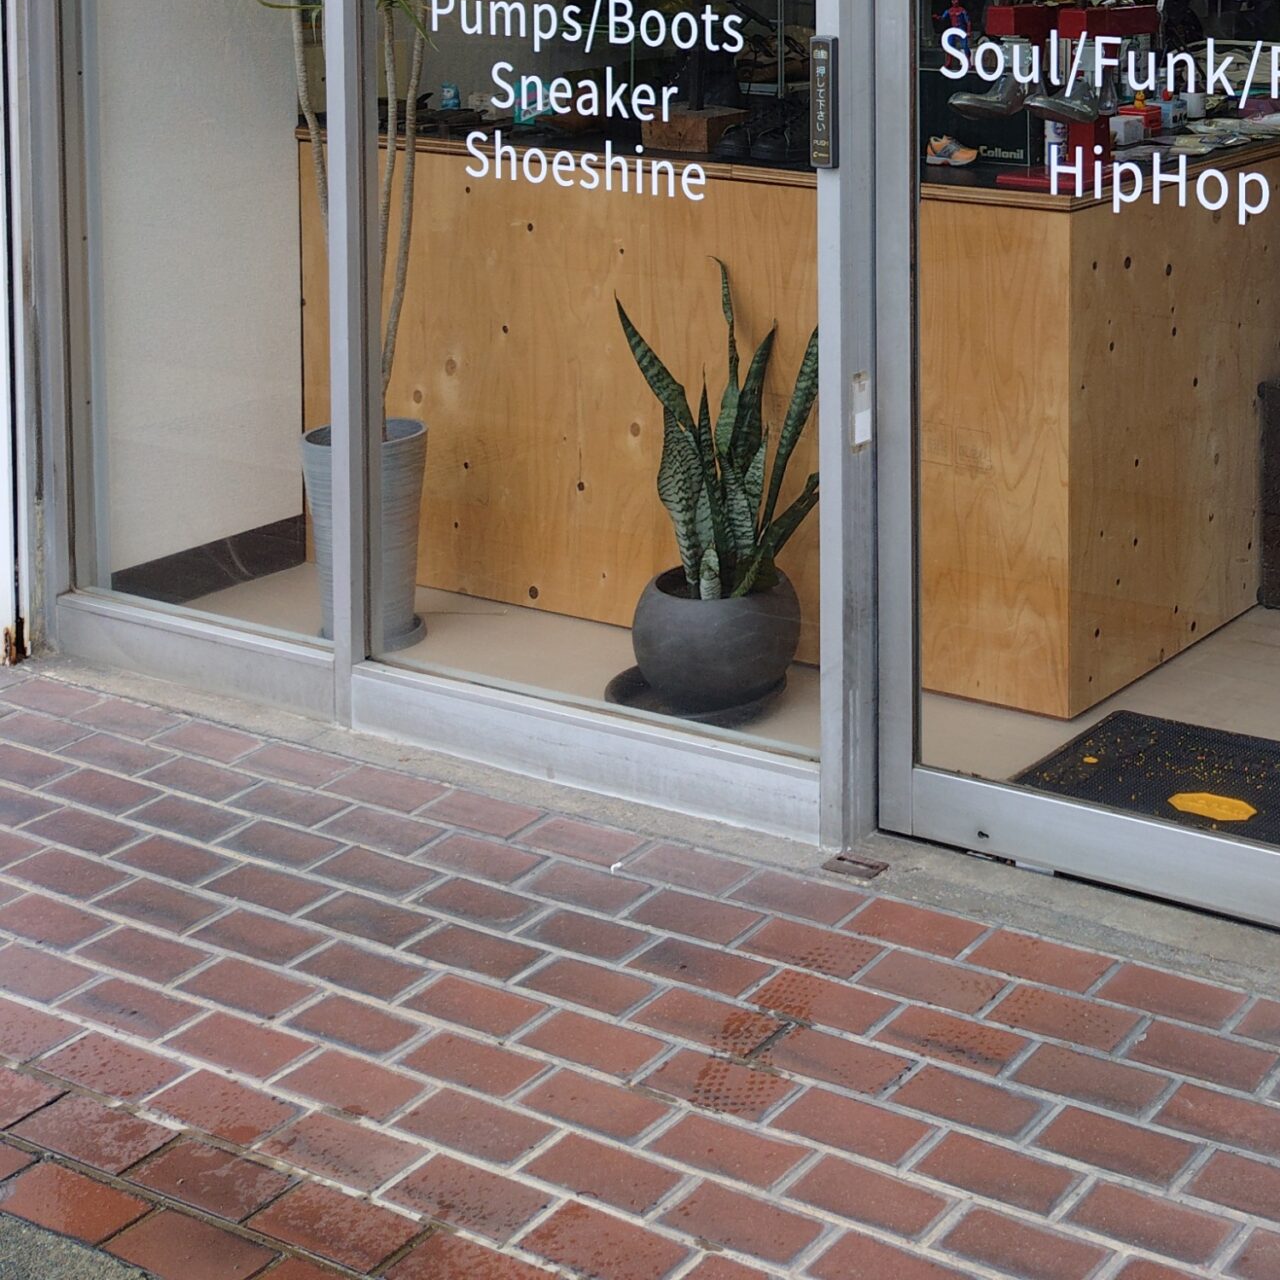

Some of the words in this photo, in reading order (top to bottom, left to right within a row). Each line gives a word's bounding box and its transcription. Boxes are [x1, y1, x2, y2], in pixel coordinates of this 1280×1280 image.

[492, 62, 678, 122] Sneaker
[816, 65, 827, 133] 押して下さい
[466, 131, 706, 202] Shoeshine
[1050, 144, 1270, 225] HipHop
